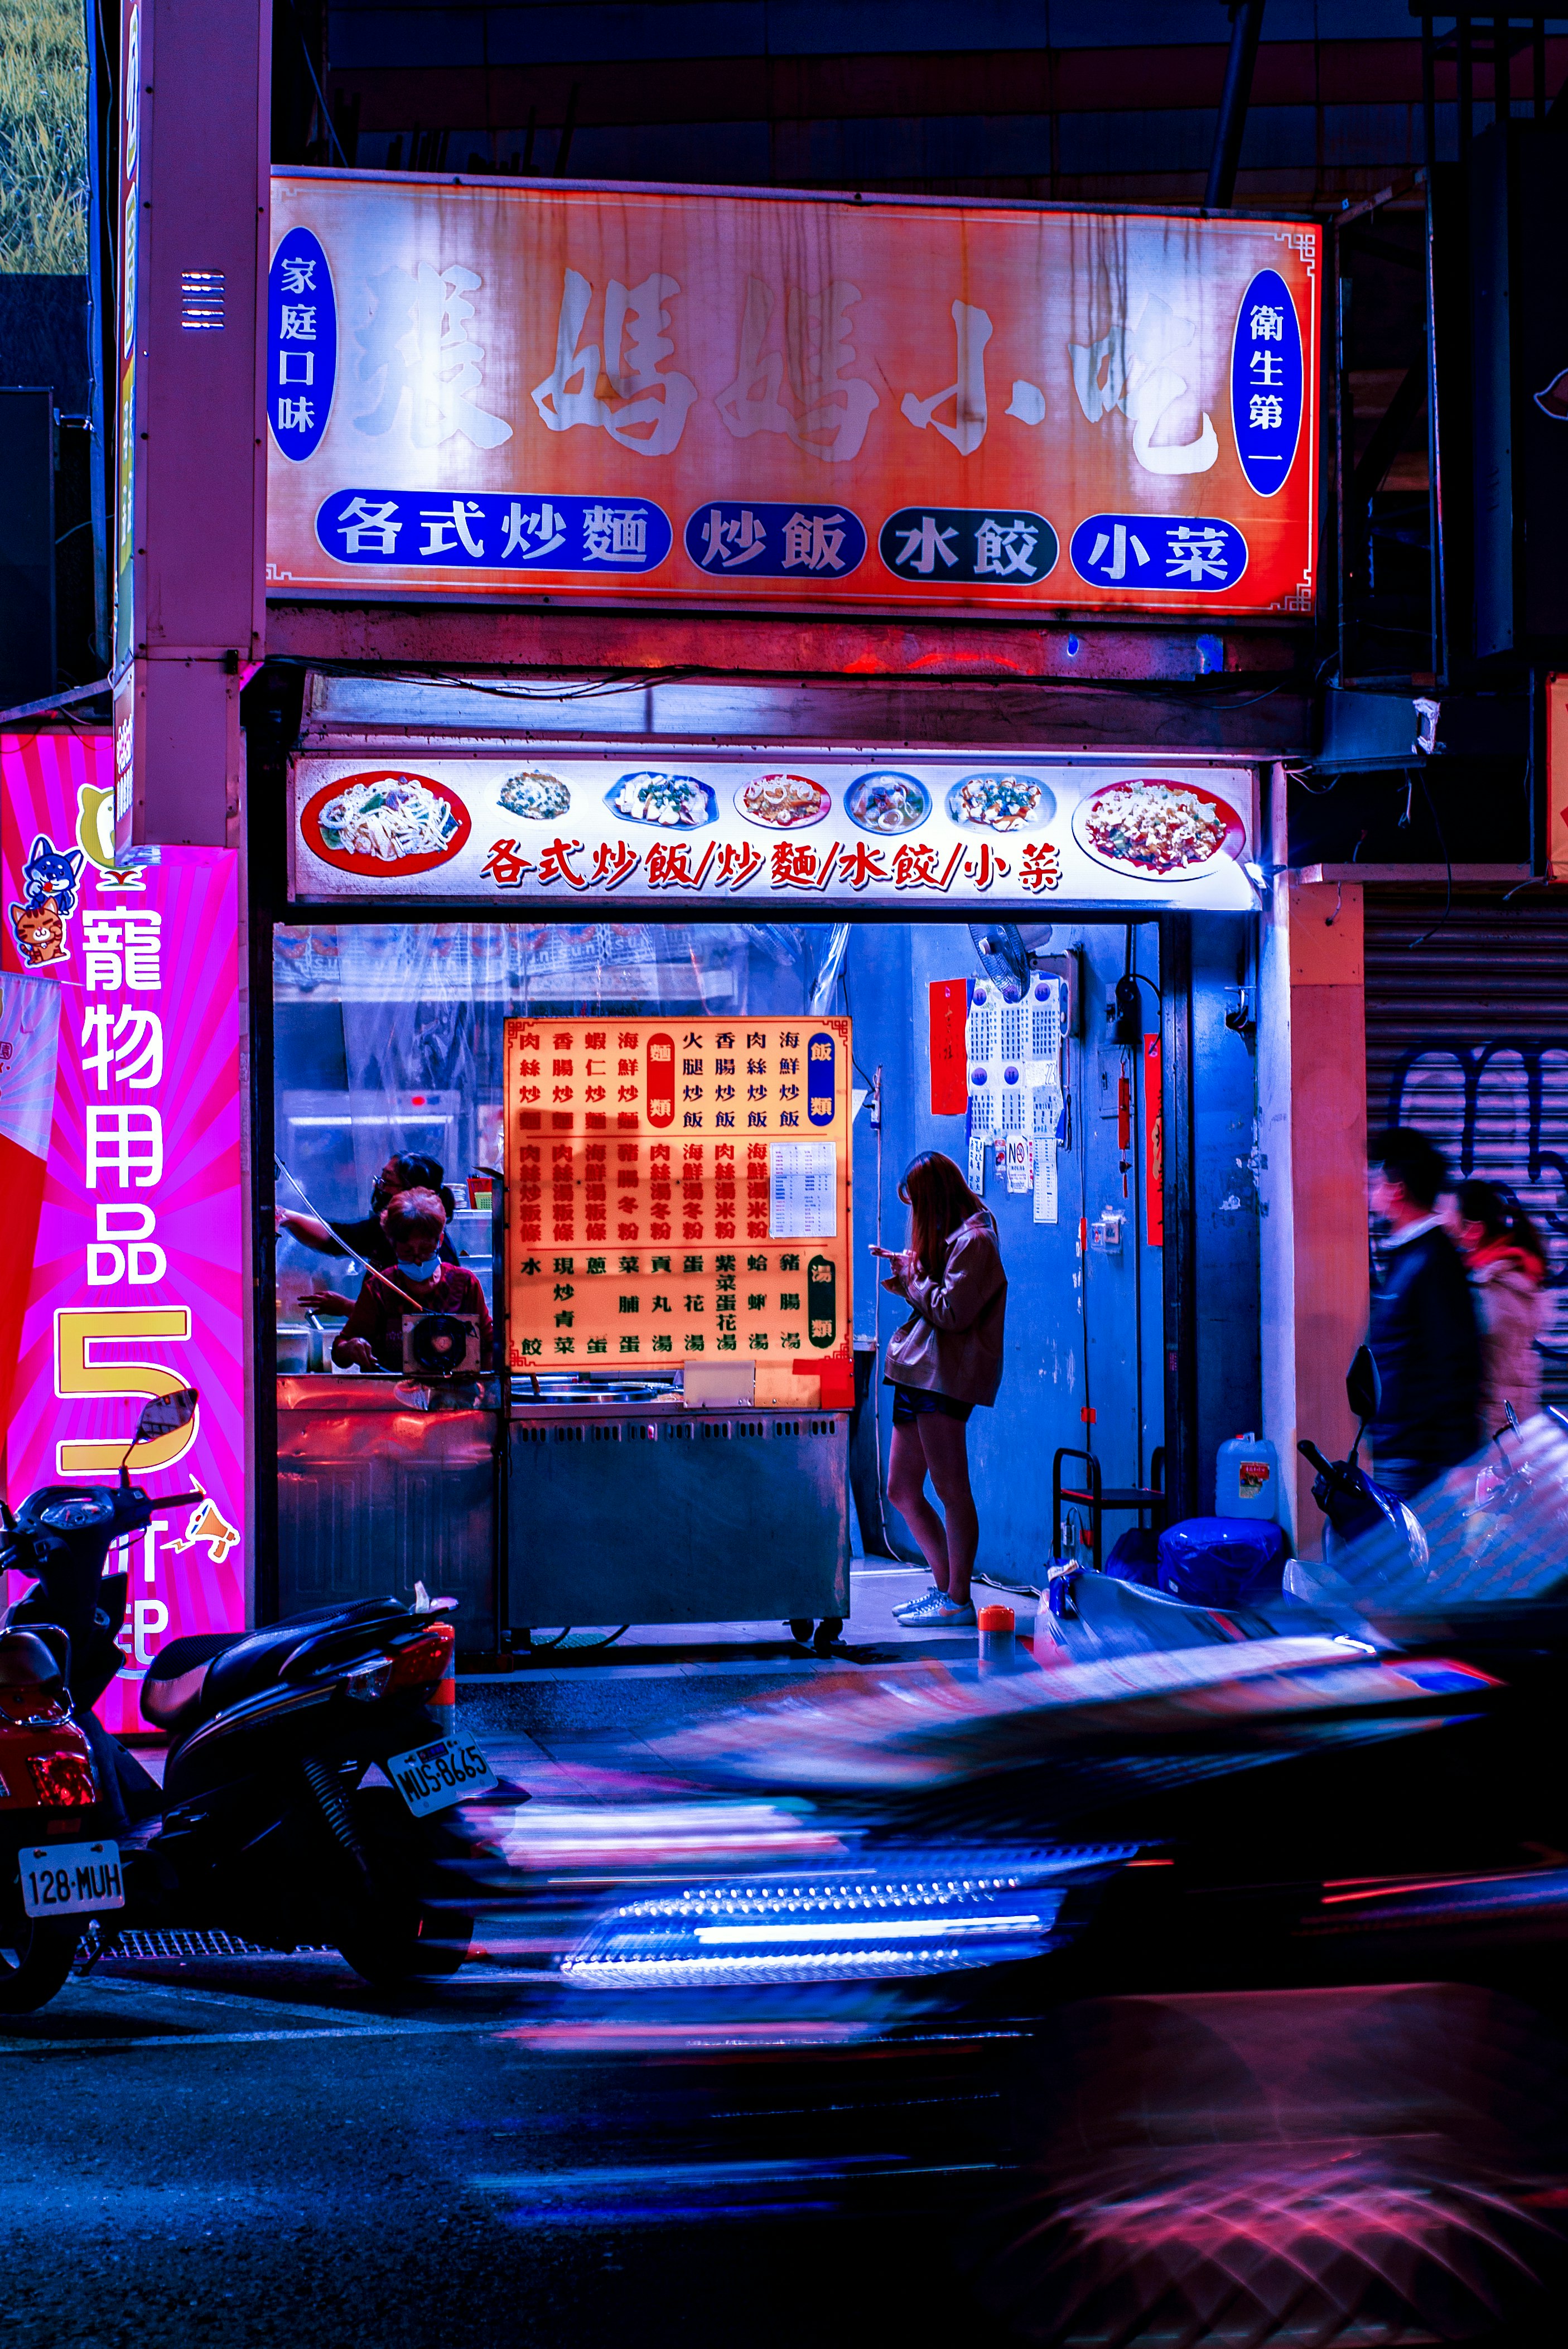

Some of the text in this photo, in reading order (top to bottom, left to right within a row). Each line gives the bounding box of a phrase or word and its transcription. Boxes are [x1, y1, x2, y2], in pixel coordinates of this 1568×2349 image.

[278, 257, 316, 433] 家庭口味
[1248, 305, 1284, 462] 衛生第一
[336, 496, 1229, 582] 各式炒麵 炒飯 水餃 小菜
[480, 838, 1063, 893] 各式炒飯/炒麵/水餃/小菜
[519, 1033, 541, 1130] 肉絲炒麵
[552, 1032, 573, 1130] 香腸炒麵
[585, 1032, 606, 1129] 蝦仁炒麵
[617, 1032, 639, 1129] 海鮮炒麵
[650, 1044, 672, 1117] 麵類
[683, 1031, 703, 1128] 火腿炒飯
[715, 1032, 736, 1128] 香腸炒飯
[746, 1031, 768, 1128] 肉絲炒飯
[779, 1031, 800, 1127] 海鮮炒飯
[810, 1043, 832, 1116] 飯類
[650, 1144, 671, 1239] 肉絲湯冬粉
[683, 1144, 703, 1239] 海鮮湯冬粉
[715, 1143, 736, 1239] 肉絲湯米粉
[747, 1143, 768, 1238] 海鮮湯米粉
[553, 1257, 575, 1354] 現炒青菜
[619, 1256, 640, 1353] 菜脯蛋
[651, 1256, 672, 1352] 貢丸湯
[683, 1255, 705, 1351] 蛋花湯
[715, 1255, 736, 1351] 紫菜蛋花湯
